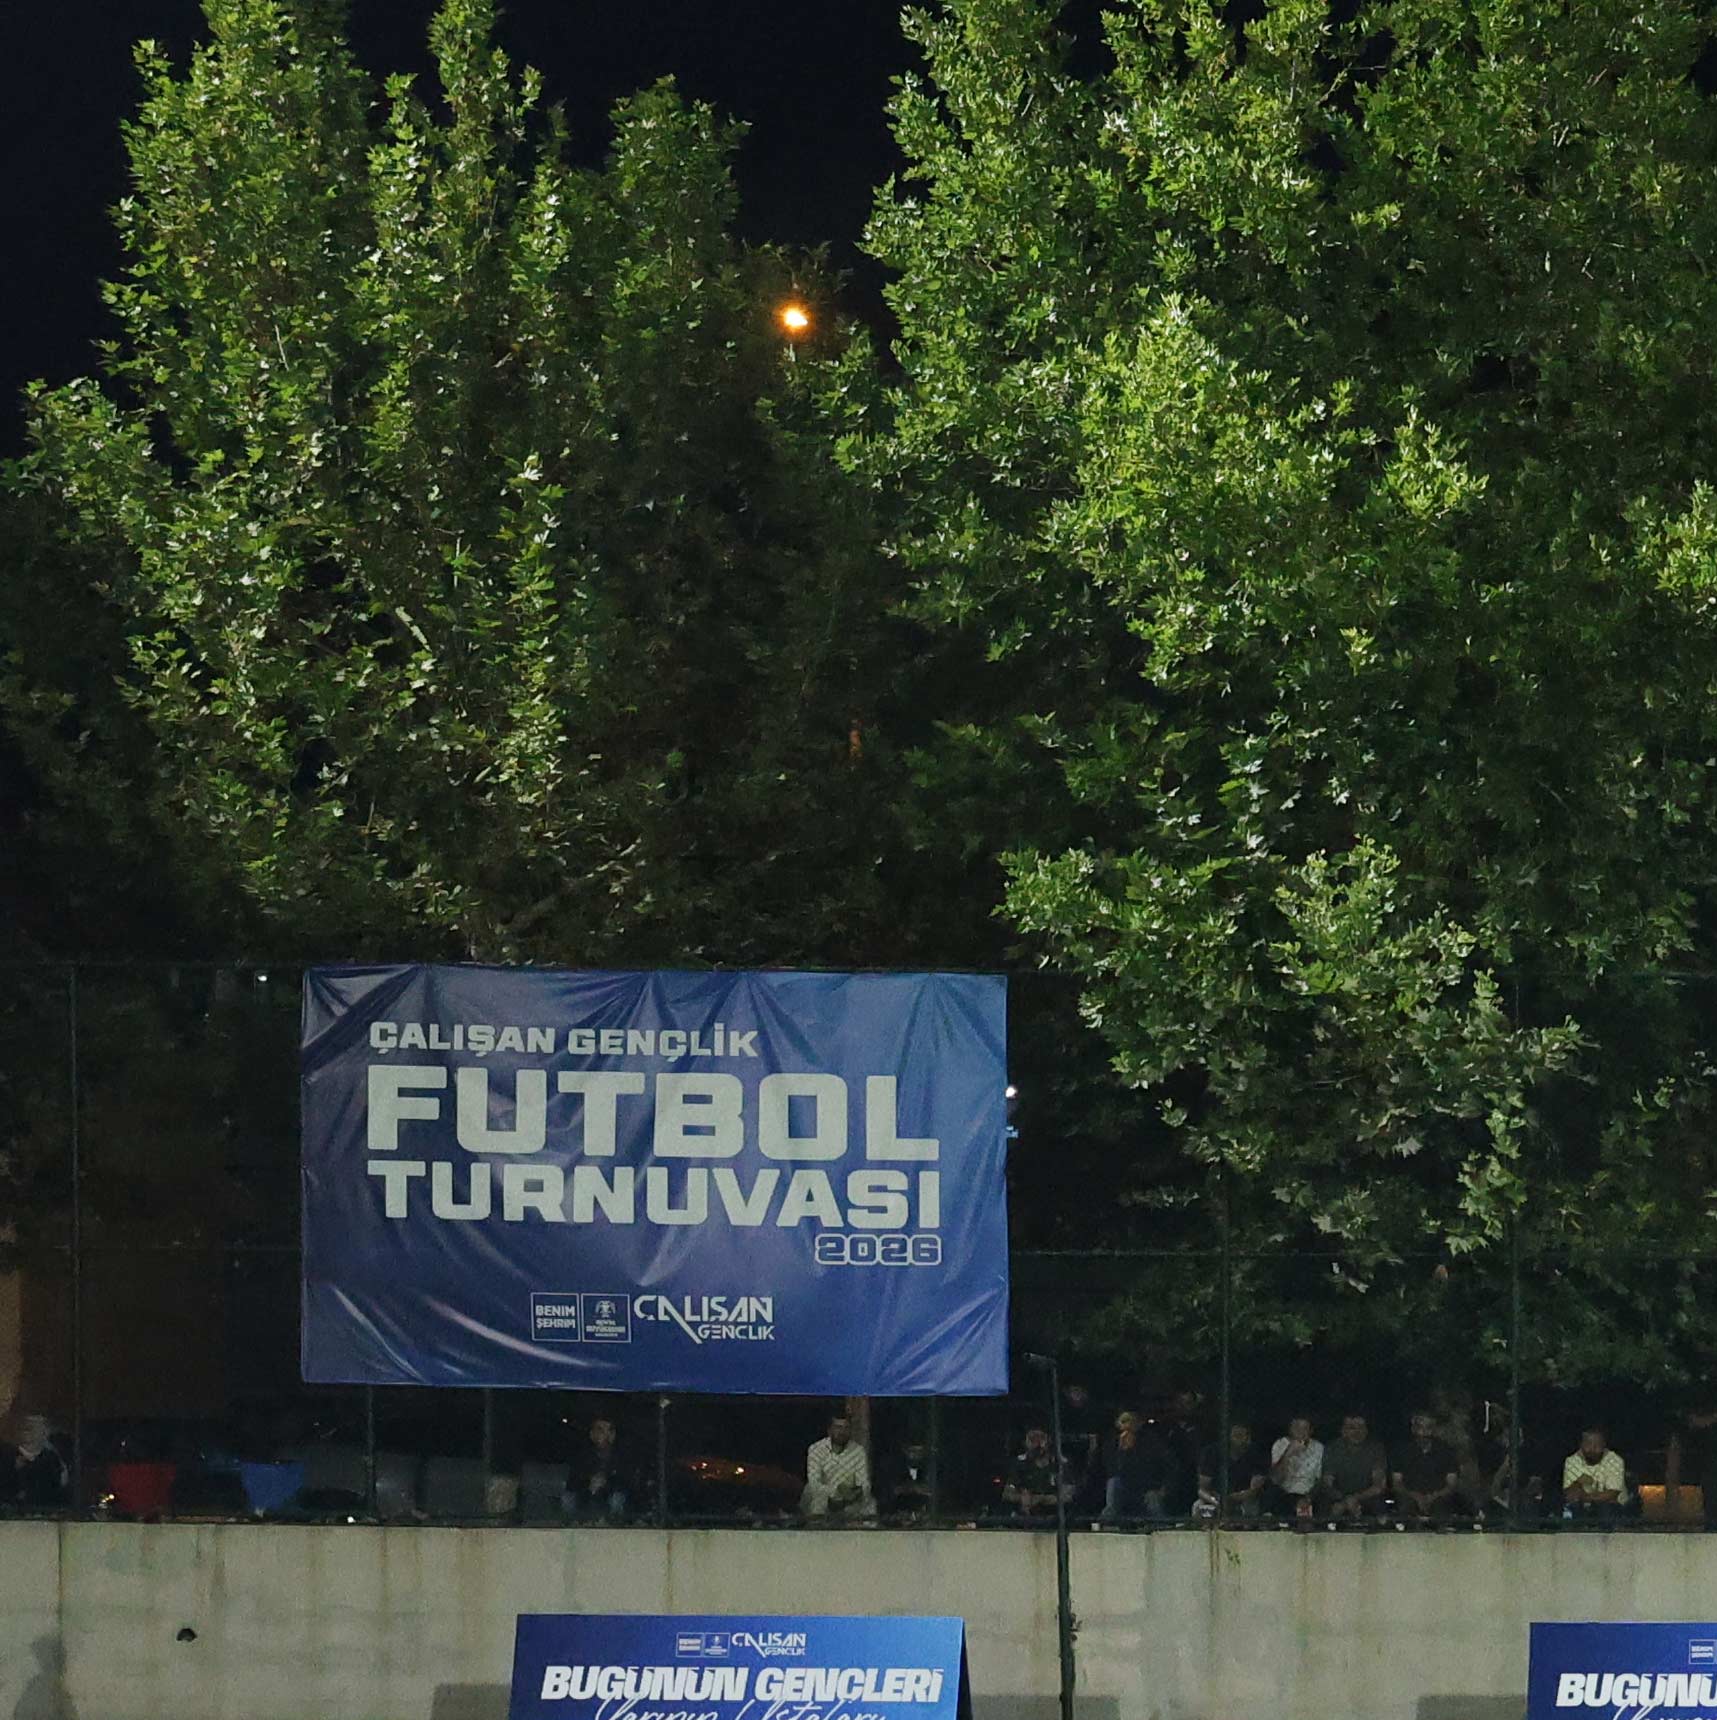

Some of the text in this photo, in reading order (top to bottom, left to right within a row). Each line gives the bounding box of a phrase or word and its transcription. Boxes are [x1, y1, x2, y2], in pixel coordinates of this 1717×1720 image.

[369, 1021, 758, 1063] ÇALIŞAN GENÇLİK
[367, 1065, 940, 1161] FUTBOL
[367, 1160, 940, 1229] TURNUVASI
[814, 1234, 942, 1265] 2026
